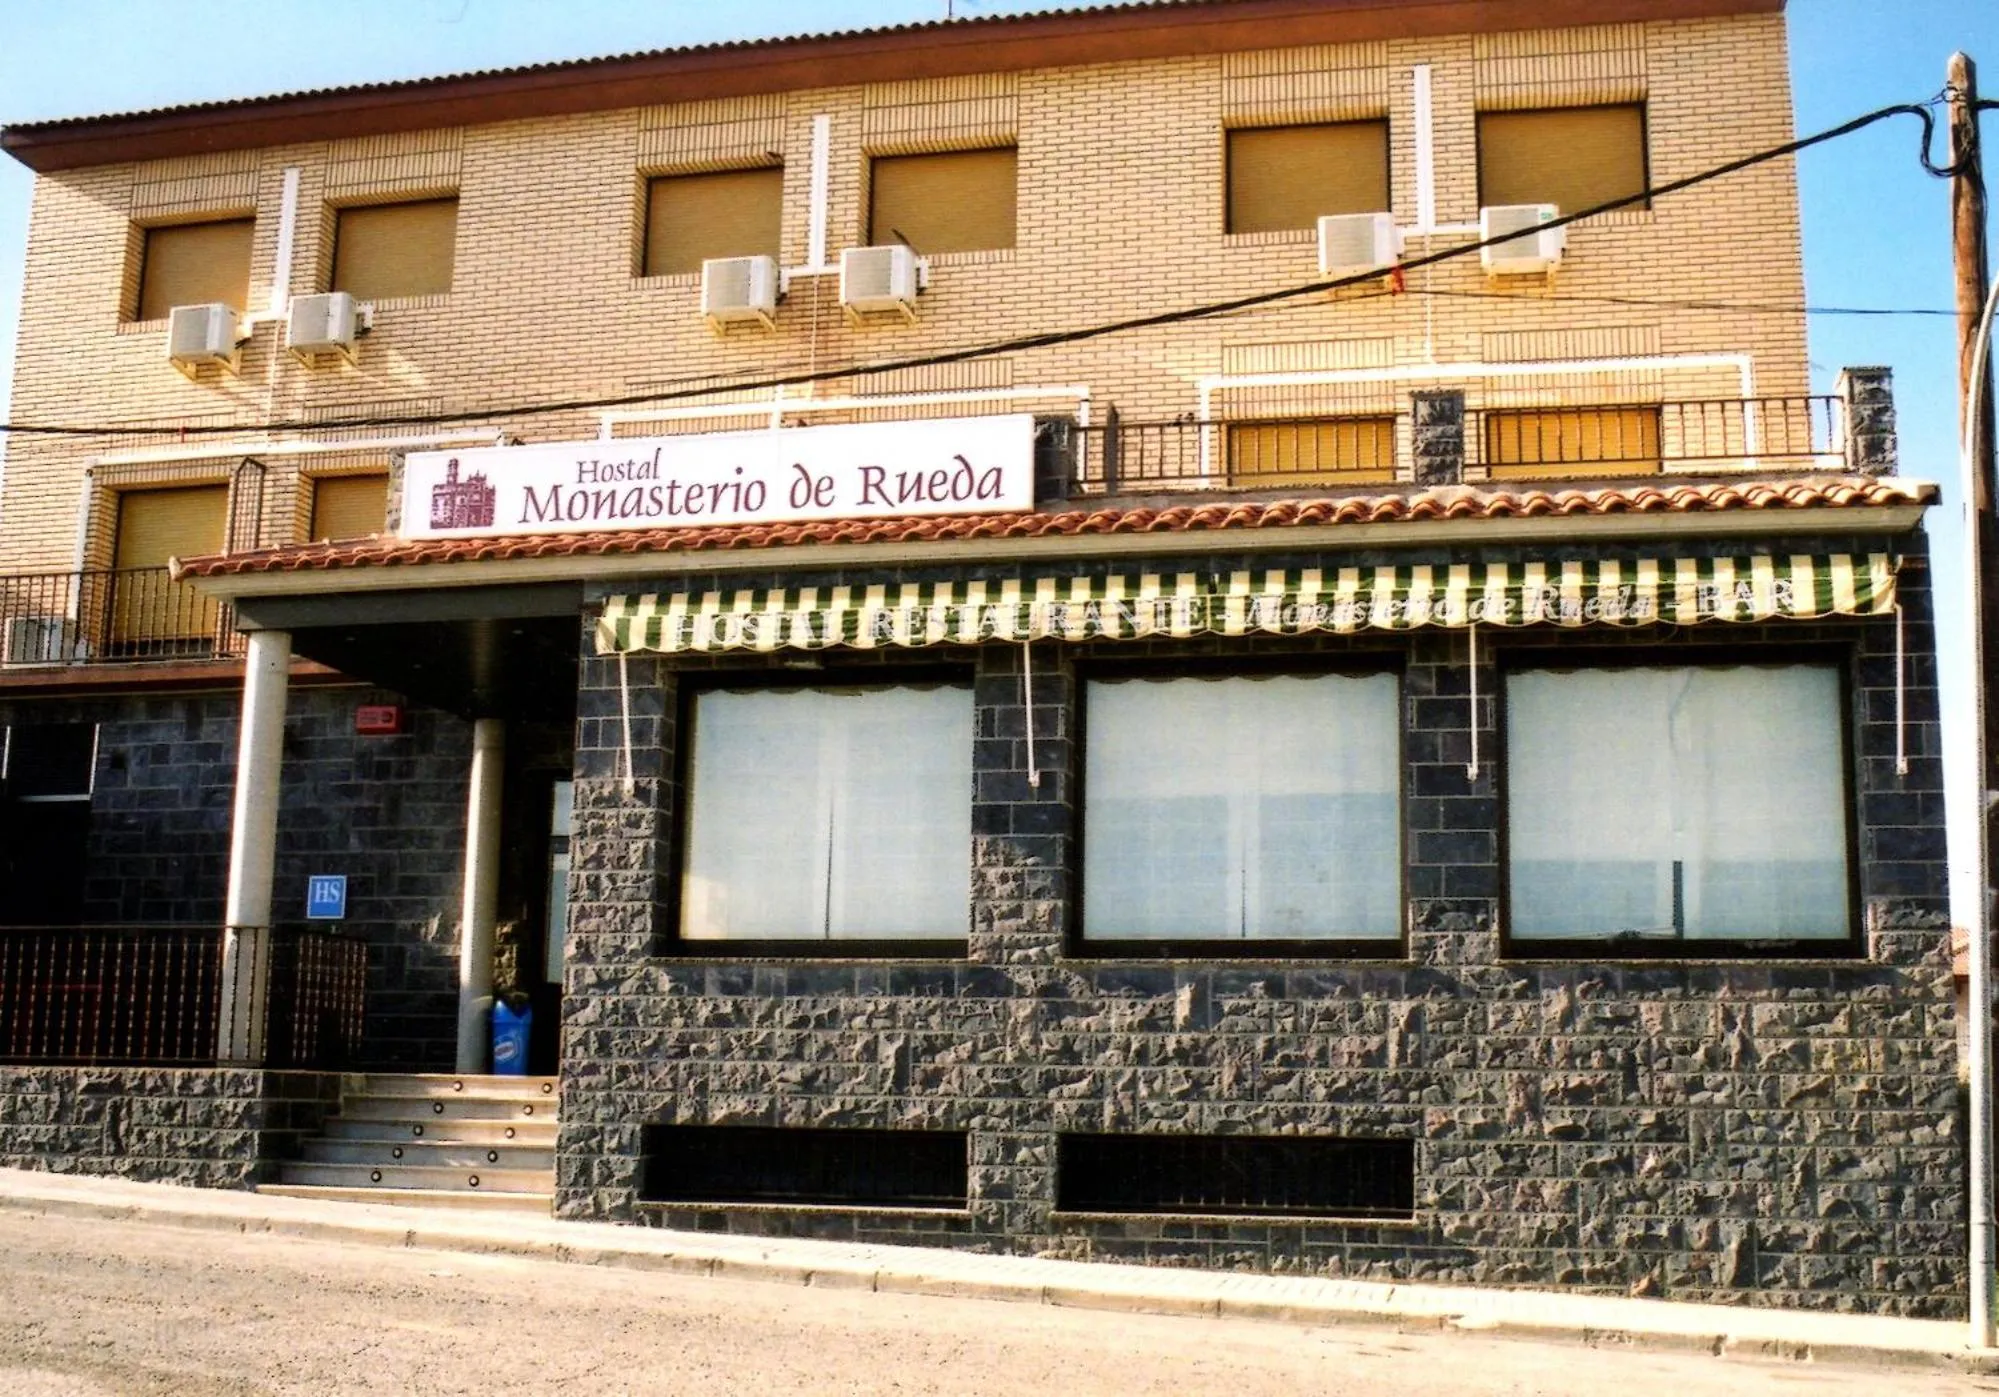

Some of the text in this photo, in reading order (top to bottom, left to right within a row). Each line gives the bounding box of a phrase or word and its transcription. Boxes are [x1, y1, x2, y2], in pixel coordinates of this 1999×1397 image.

[518, 453, 1005, 524] Monasterio de Rueda
[577, 447, 662, 484] Hostal
[675, 611, 845, 646] HOSTAL
[868, 597, 1206, 640] RESTAURANTE
[1244, 591, 1454, 626] Monasterio
[1468, 587, 1517, 620] de
[1525, 584, 1651, 619] Rueda
[1696, 579, 1797, 615] BAR
[314, 880, 341, 904] HS
